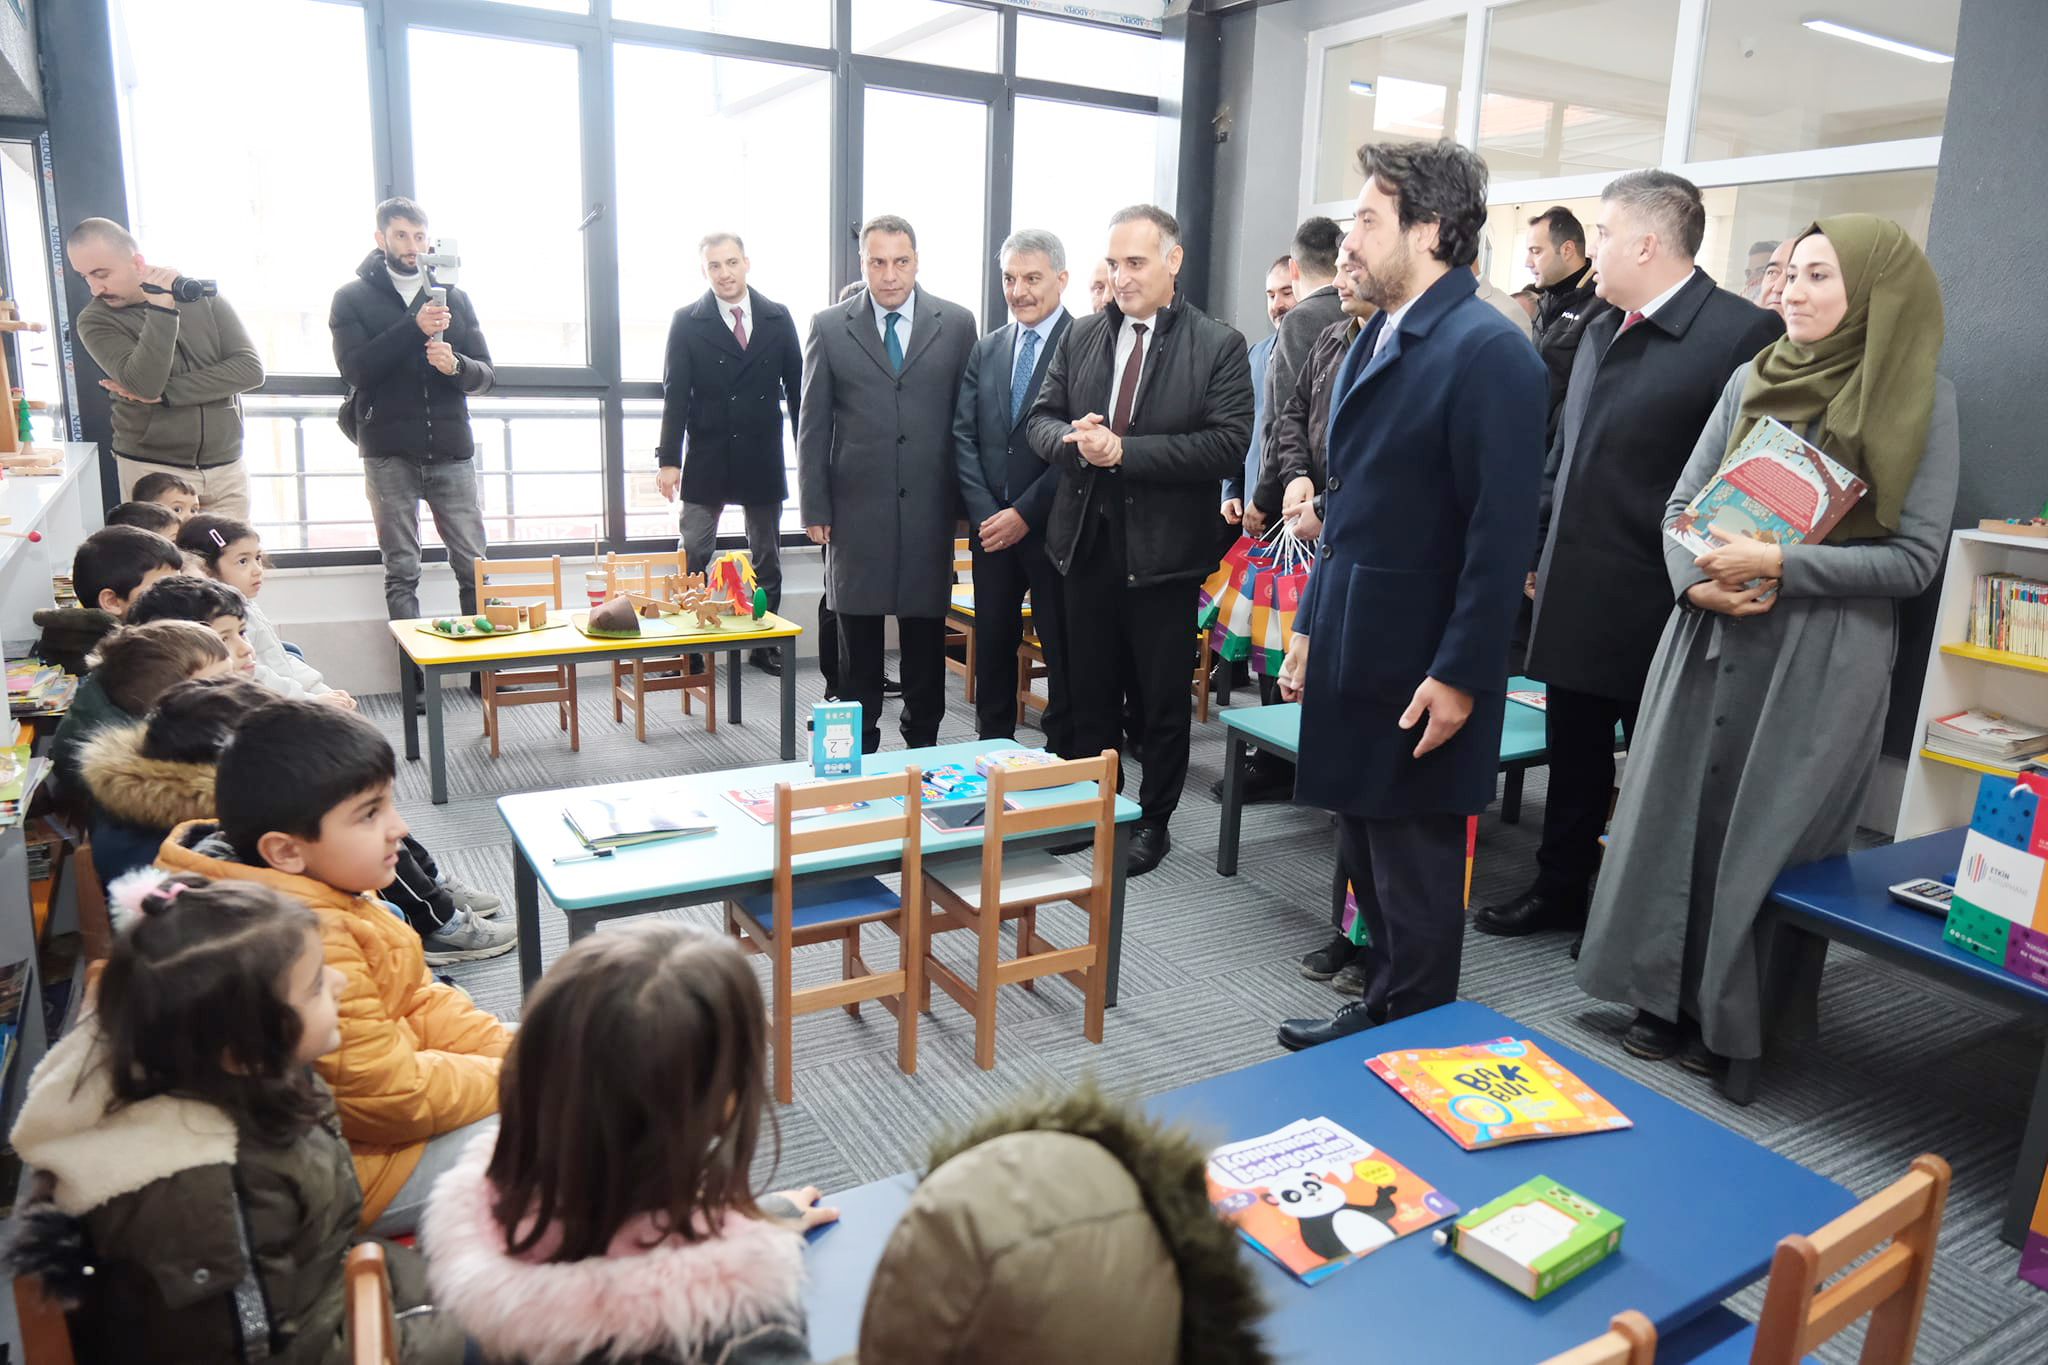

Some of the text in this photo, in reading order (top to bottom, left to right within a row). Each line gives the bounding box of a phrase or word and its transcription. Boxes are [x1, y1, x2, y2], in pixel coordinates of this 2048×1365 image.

[50, 225, 63, 265] ADOPEN
[1453, 1064, 1529, 1091] BAK
[1488, 1081, 1538, 1103] BUL
